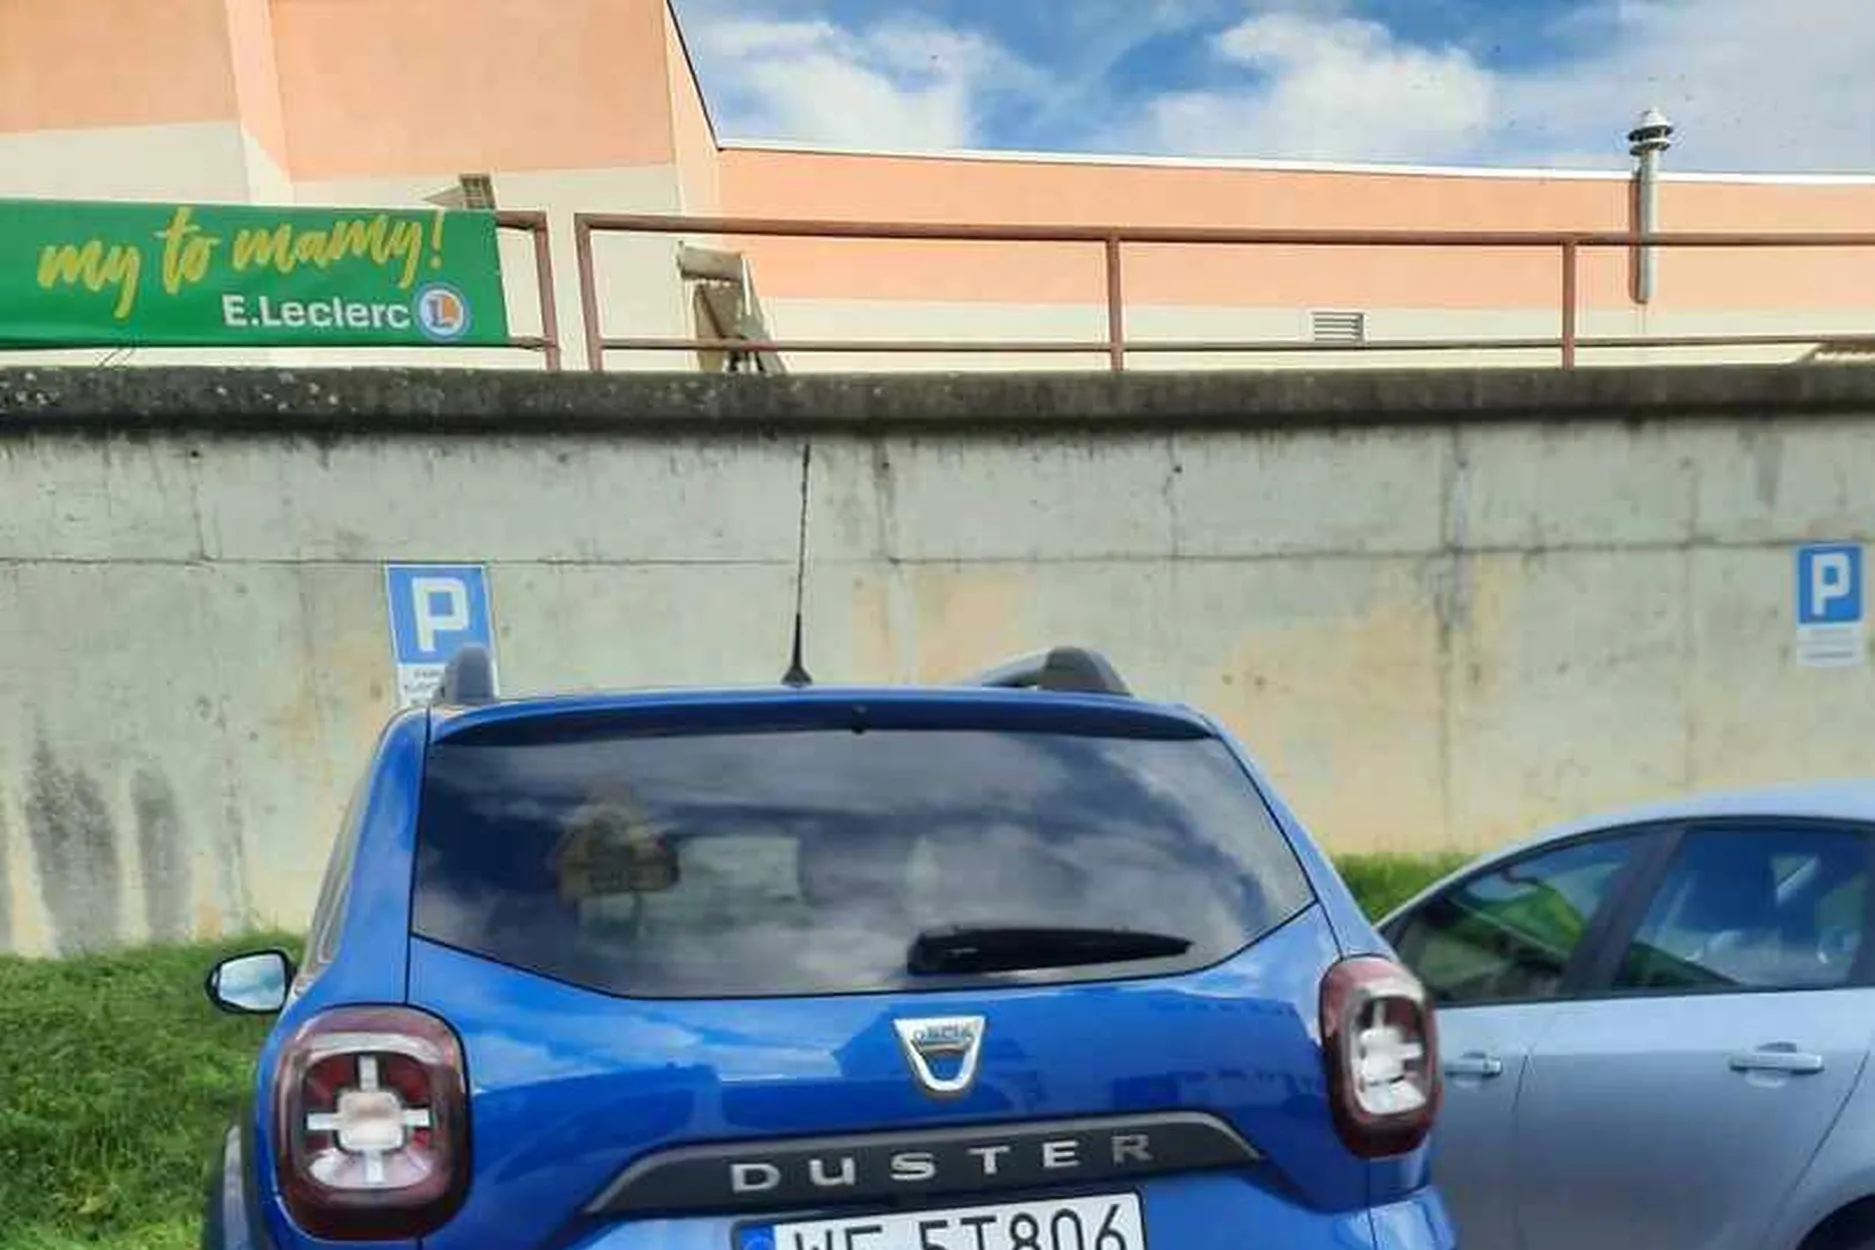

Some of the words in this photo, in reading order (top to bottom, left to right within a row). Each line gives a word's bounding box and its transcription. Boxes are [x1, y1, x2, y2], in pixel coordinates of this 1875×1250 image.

[38, 240, 141, 318] my
[152, 206, 221, 294] to
[232, 209, 445, 289] mamy!
[222, 294, 411, 330] E.Leclerc
[411, 576, 470, 652] P
[1811, 552, 1850, 616] P
[730, 1134, 1155, 1194] DUSTER
